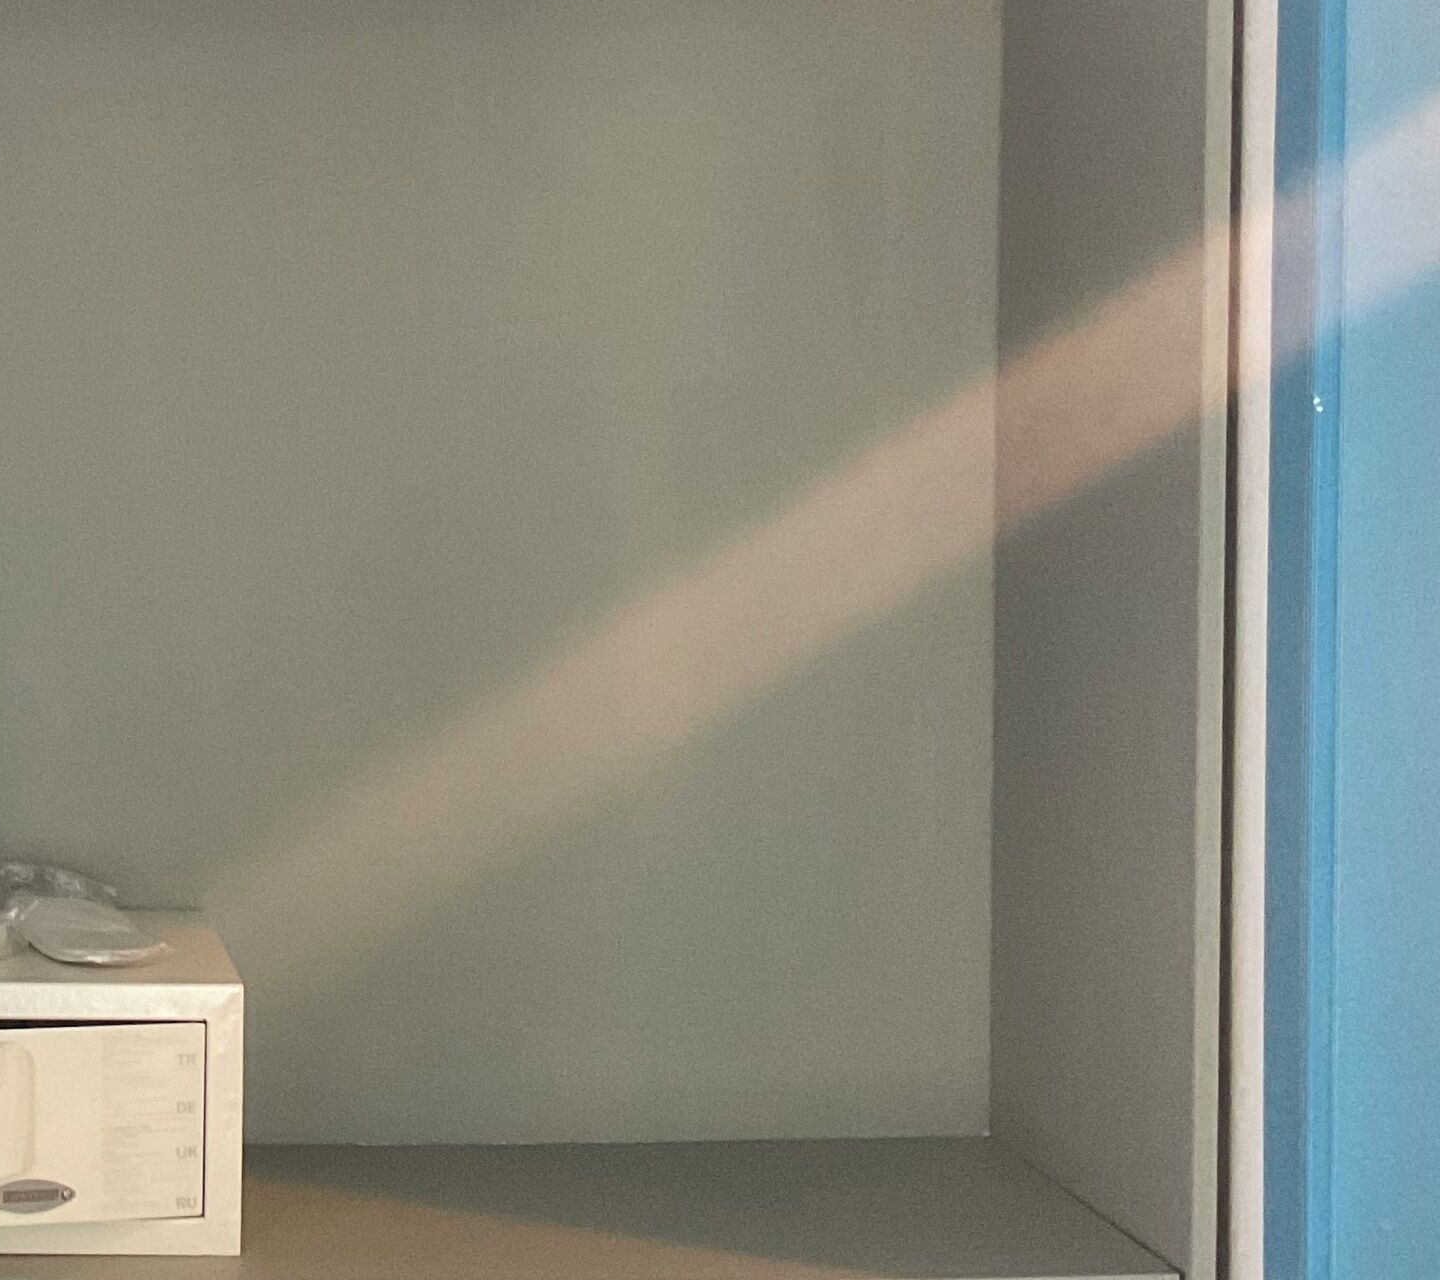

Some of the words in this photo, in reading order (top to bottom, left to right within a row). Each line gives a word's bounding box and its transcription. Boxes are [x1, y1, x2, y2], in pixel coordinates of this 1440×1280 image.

[176, 1053, 197, 1067] TR
[176, 1101, 197, 1114] DE
[176, 1146, 198, 1160] UK
[176, 1197, 197, 1210] RU
